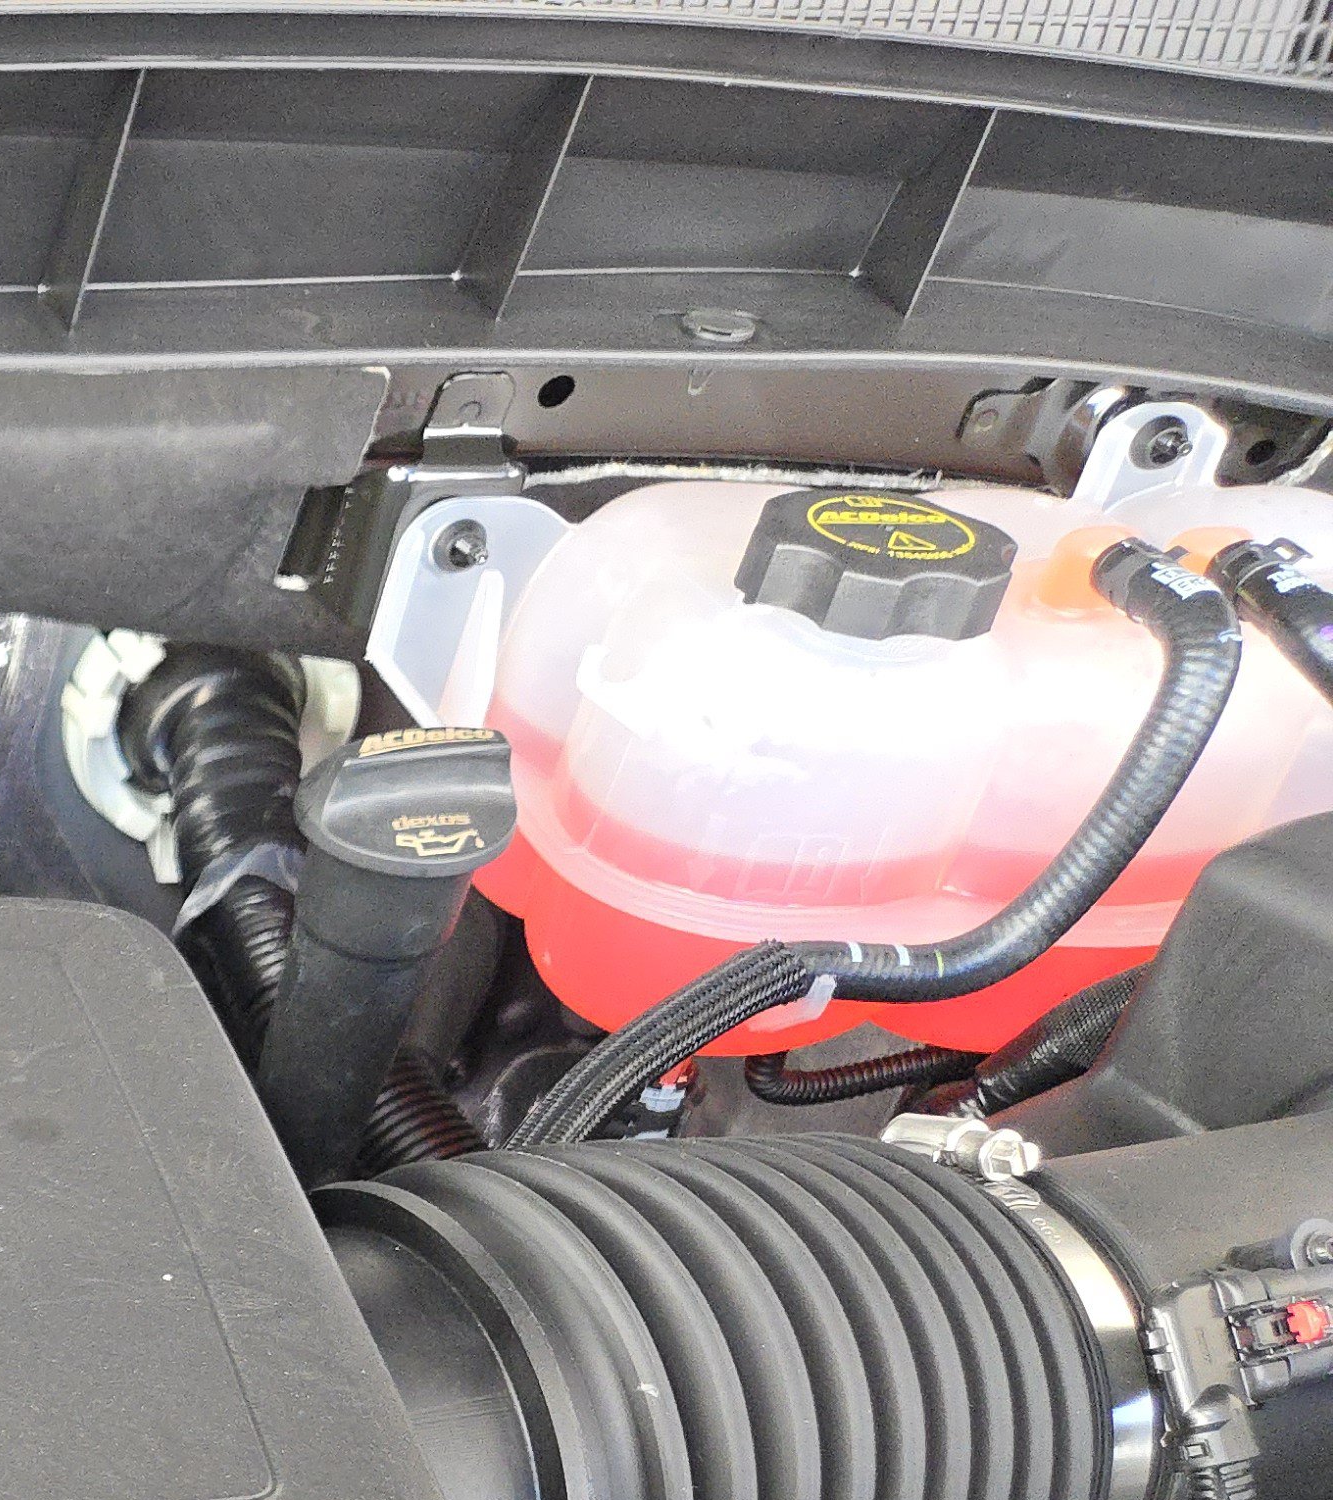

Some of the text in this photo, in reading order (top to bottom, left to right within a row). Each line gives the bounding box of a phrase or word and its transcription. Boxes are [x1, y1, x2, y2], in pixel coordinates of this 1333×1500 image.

[816, 510, 947, 525] ACDelco
[358, 727, 496, 757] ACDelco
[391, 811, 471, 831] dexos
